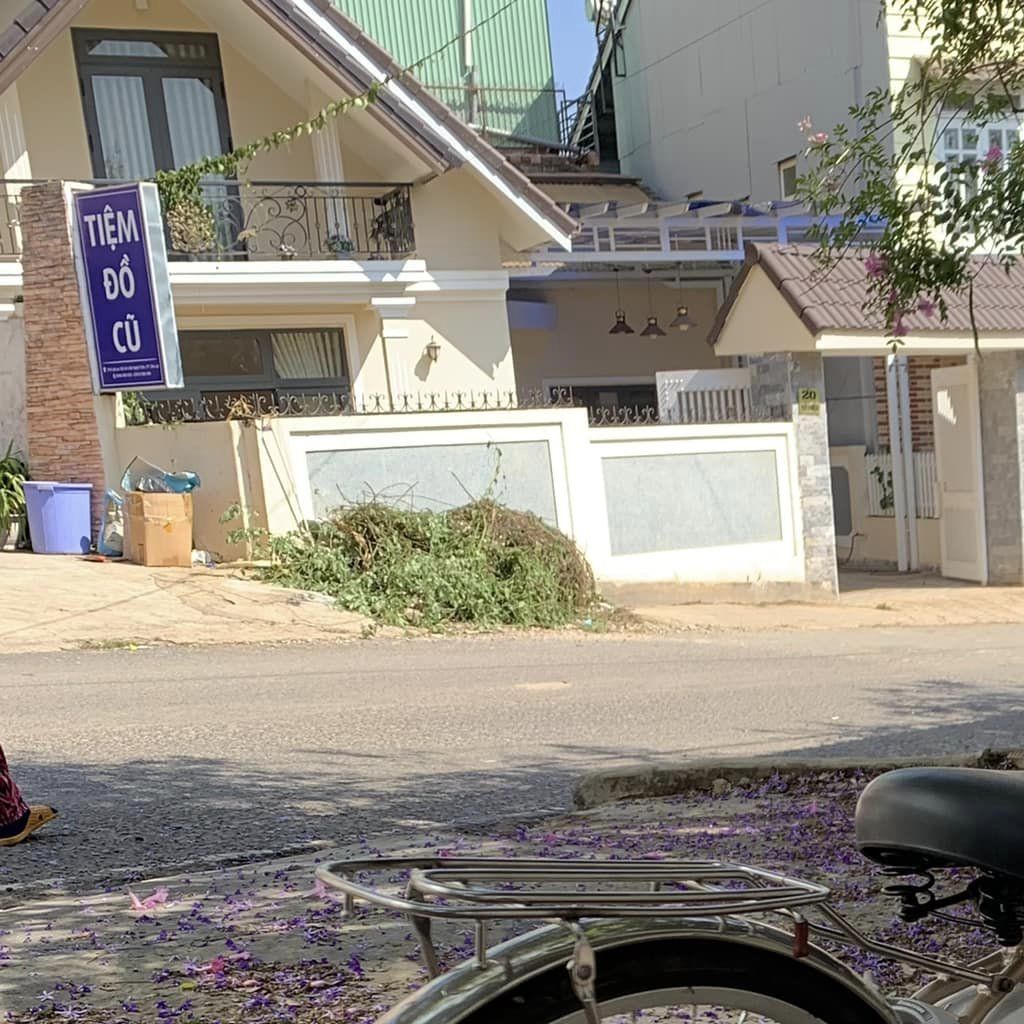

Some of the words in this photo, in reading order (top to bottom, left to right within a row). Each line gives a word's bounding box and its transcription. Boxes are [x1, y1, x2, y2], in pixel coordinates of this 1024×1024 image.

[83, 204, 140, 251] TIỆM
[102, 253, 135, 300] ĐỒ
[112, 313, 142, 354] CŨ
[801, 390, 816, 400] 20
